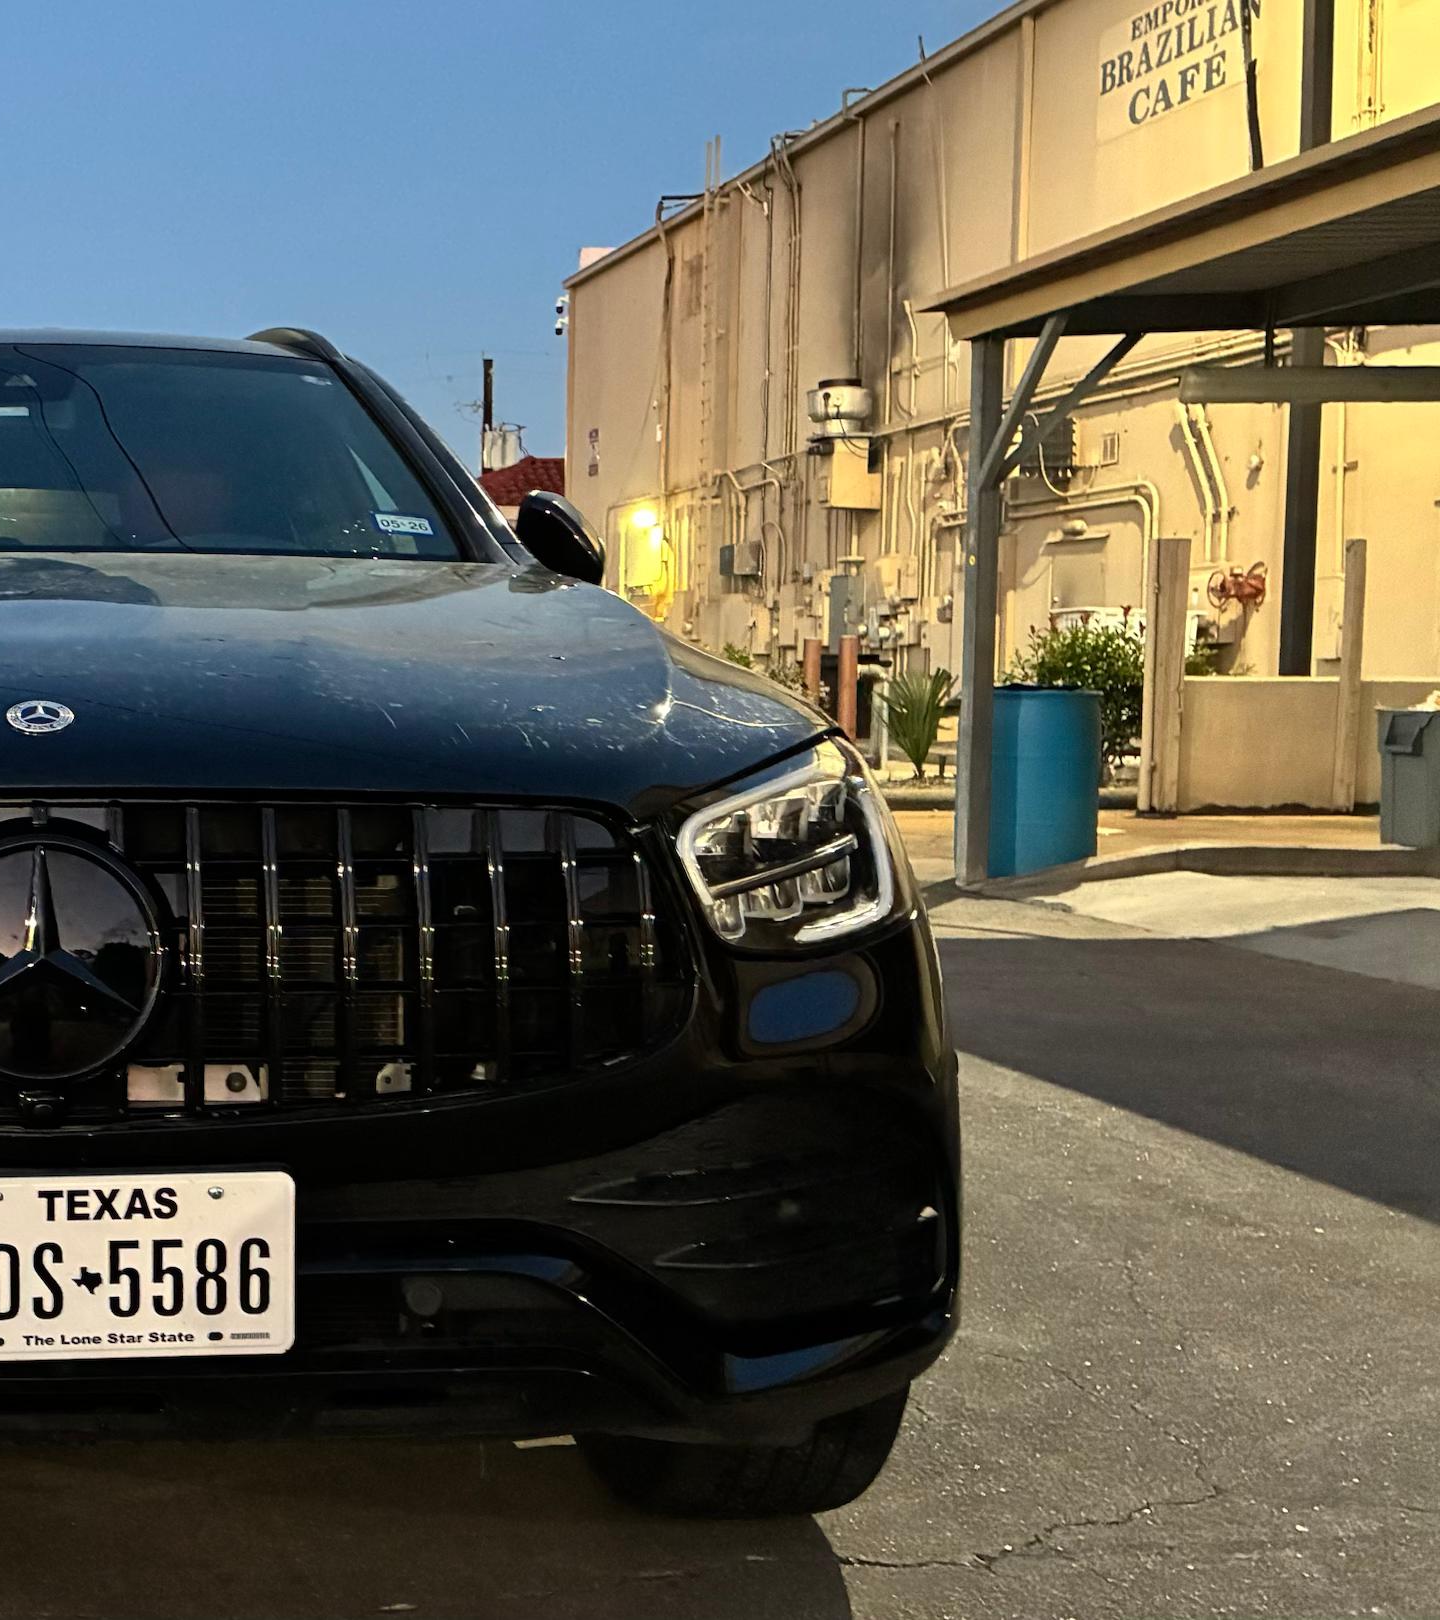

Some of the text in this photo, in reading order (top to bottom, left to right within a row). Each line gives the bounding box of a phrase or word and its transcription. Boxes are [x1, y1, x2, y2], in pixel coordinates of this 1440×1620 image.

[1131, 0, 1212, 41] EMPO
[1128, 43, 1227, 125] CAFÉ
[38, 1187, 178, 1221] TEXAS
[22, 1331, 195, 1346] The Lone Star State
